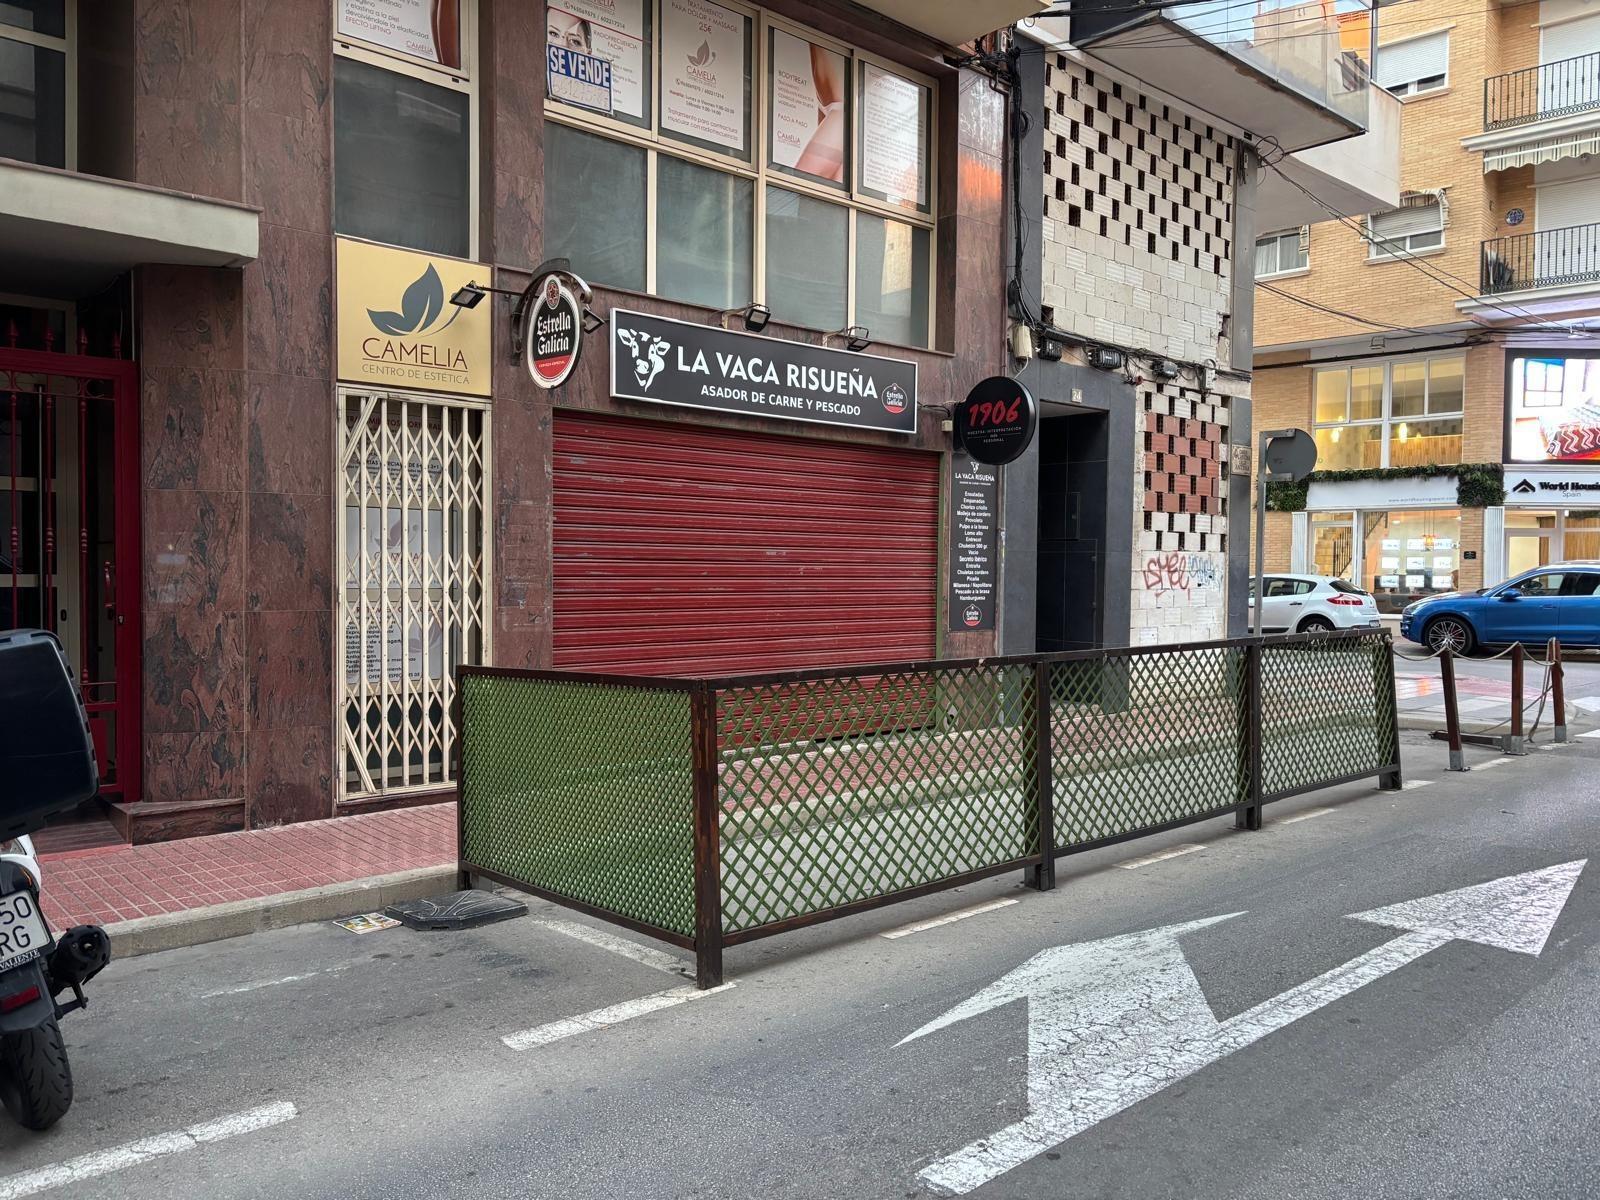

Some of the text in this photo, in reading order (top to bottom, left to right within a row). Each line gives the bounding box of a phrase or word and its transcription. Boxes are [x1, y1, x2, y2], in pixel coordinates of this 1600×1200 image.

[346, 16, 368, 28] EFECTO
[549, 46, 610, 88] SE VENDE
[686, 66, 716, 82] CAMELIA
[778, 70, 808, 86] BODYTREAT
[536, 312, 571, 336] Estrella
[362, 337, 468, 370] CAMELIA
[538, 332, 569, 355] Galicia
[362, 363, 406, 377] CENTRO
[408, 368, 421, 379] DE
[677, 345, 878, 399] LA VACA RISUEÑA
[700, 384, 862, 416] ASADOR DE CARNE Y PESCADO
[970, 396, 1022, 427] 1906
[975, 473, 995, 482] RISUEÑA
[1539, 482, 1570, 490] World
[1562, 490, 1582, 499] Spain
[0, 896, 32, 925] 50
[0, 949, 40, 970] VALIENTE
